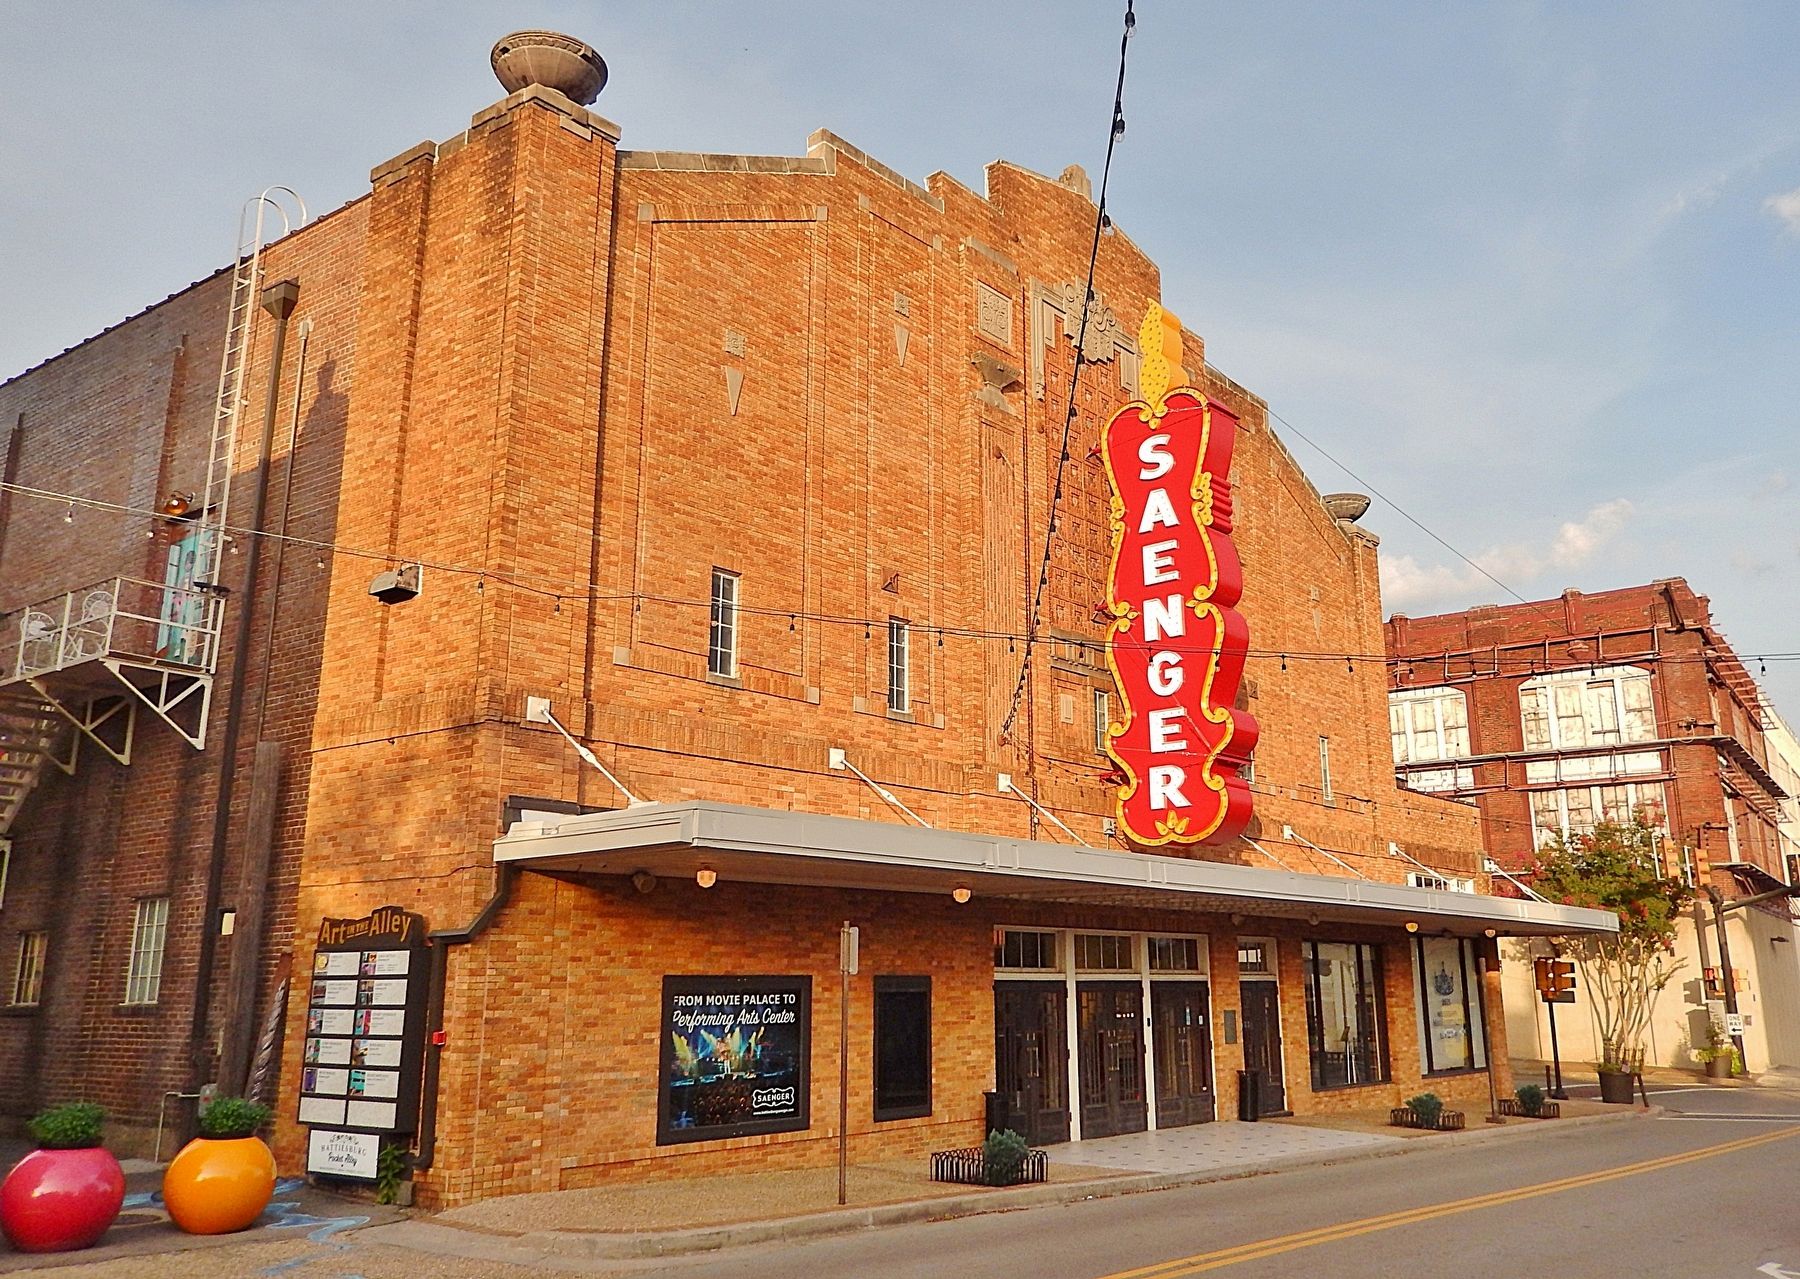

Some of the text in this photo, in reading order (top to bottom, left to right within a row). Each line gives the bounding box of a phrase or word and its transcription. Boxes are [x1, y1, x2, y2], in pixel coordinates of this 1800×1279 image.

[1138, 433, 1193, 811] SAENGER
[320, 921, 346, 944] Art
[356, 920, 370, 933] THE
[368, 910, 411, 943] Alley
[673, 994, 796, 1006] FROM MOVIE PALACE TO
[672, 1007, 796, 1033] Performing Arts Center
[757, 1092, 790, 1102] SAENGER
